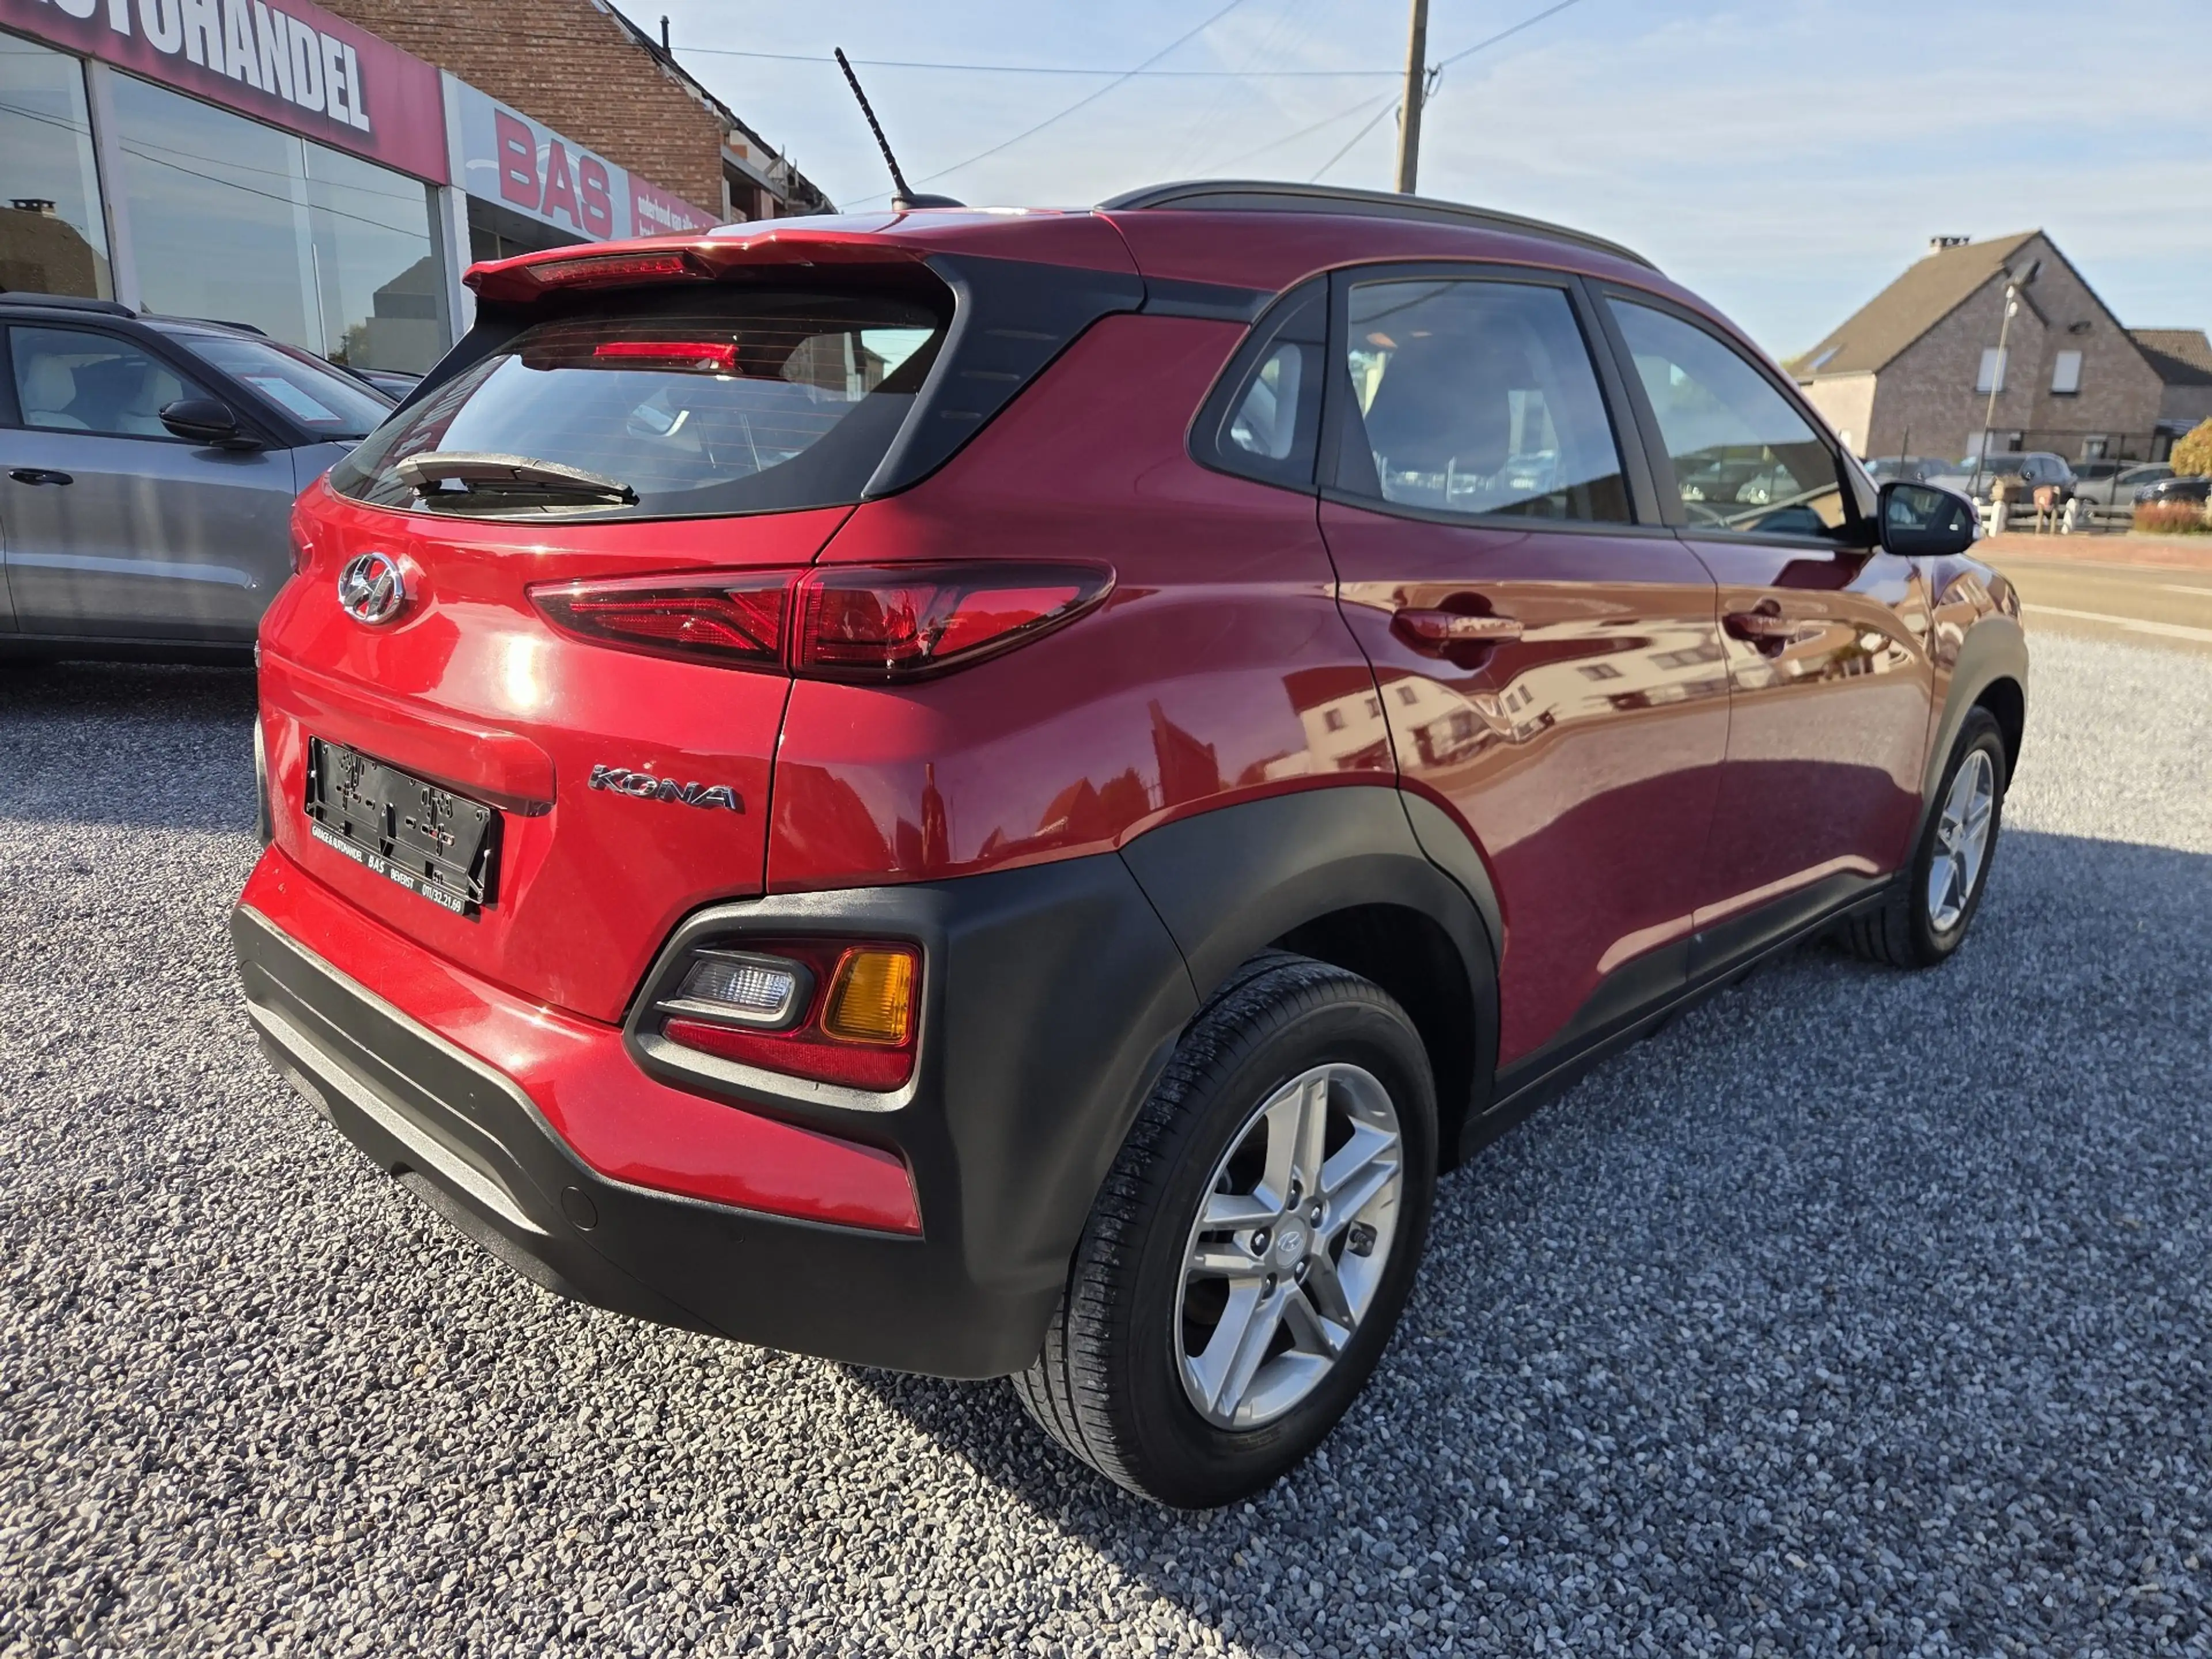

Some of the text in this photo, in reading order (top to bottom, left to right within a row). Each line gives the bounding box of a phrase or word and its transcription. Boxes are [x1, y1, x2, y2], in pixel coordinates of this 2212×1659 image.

[40, 0, 370, 132] OHANDEL
[494, 108, 613, 241] BAS
[588, 764, 736, 810] KONA
[368, 855, 385, 874] BAS
